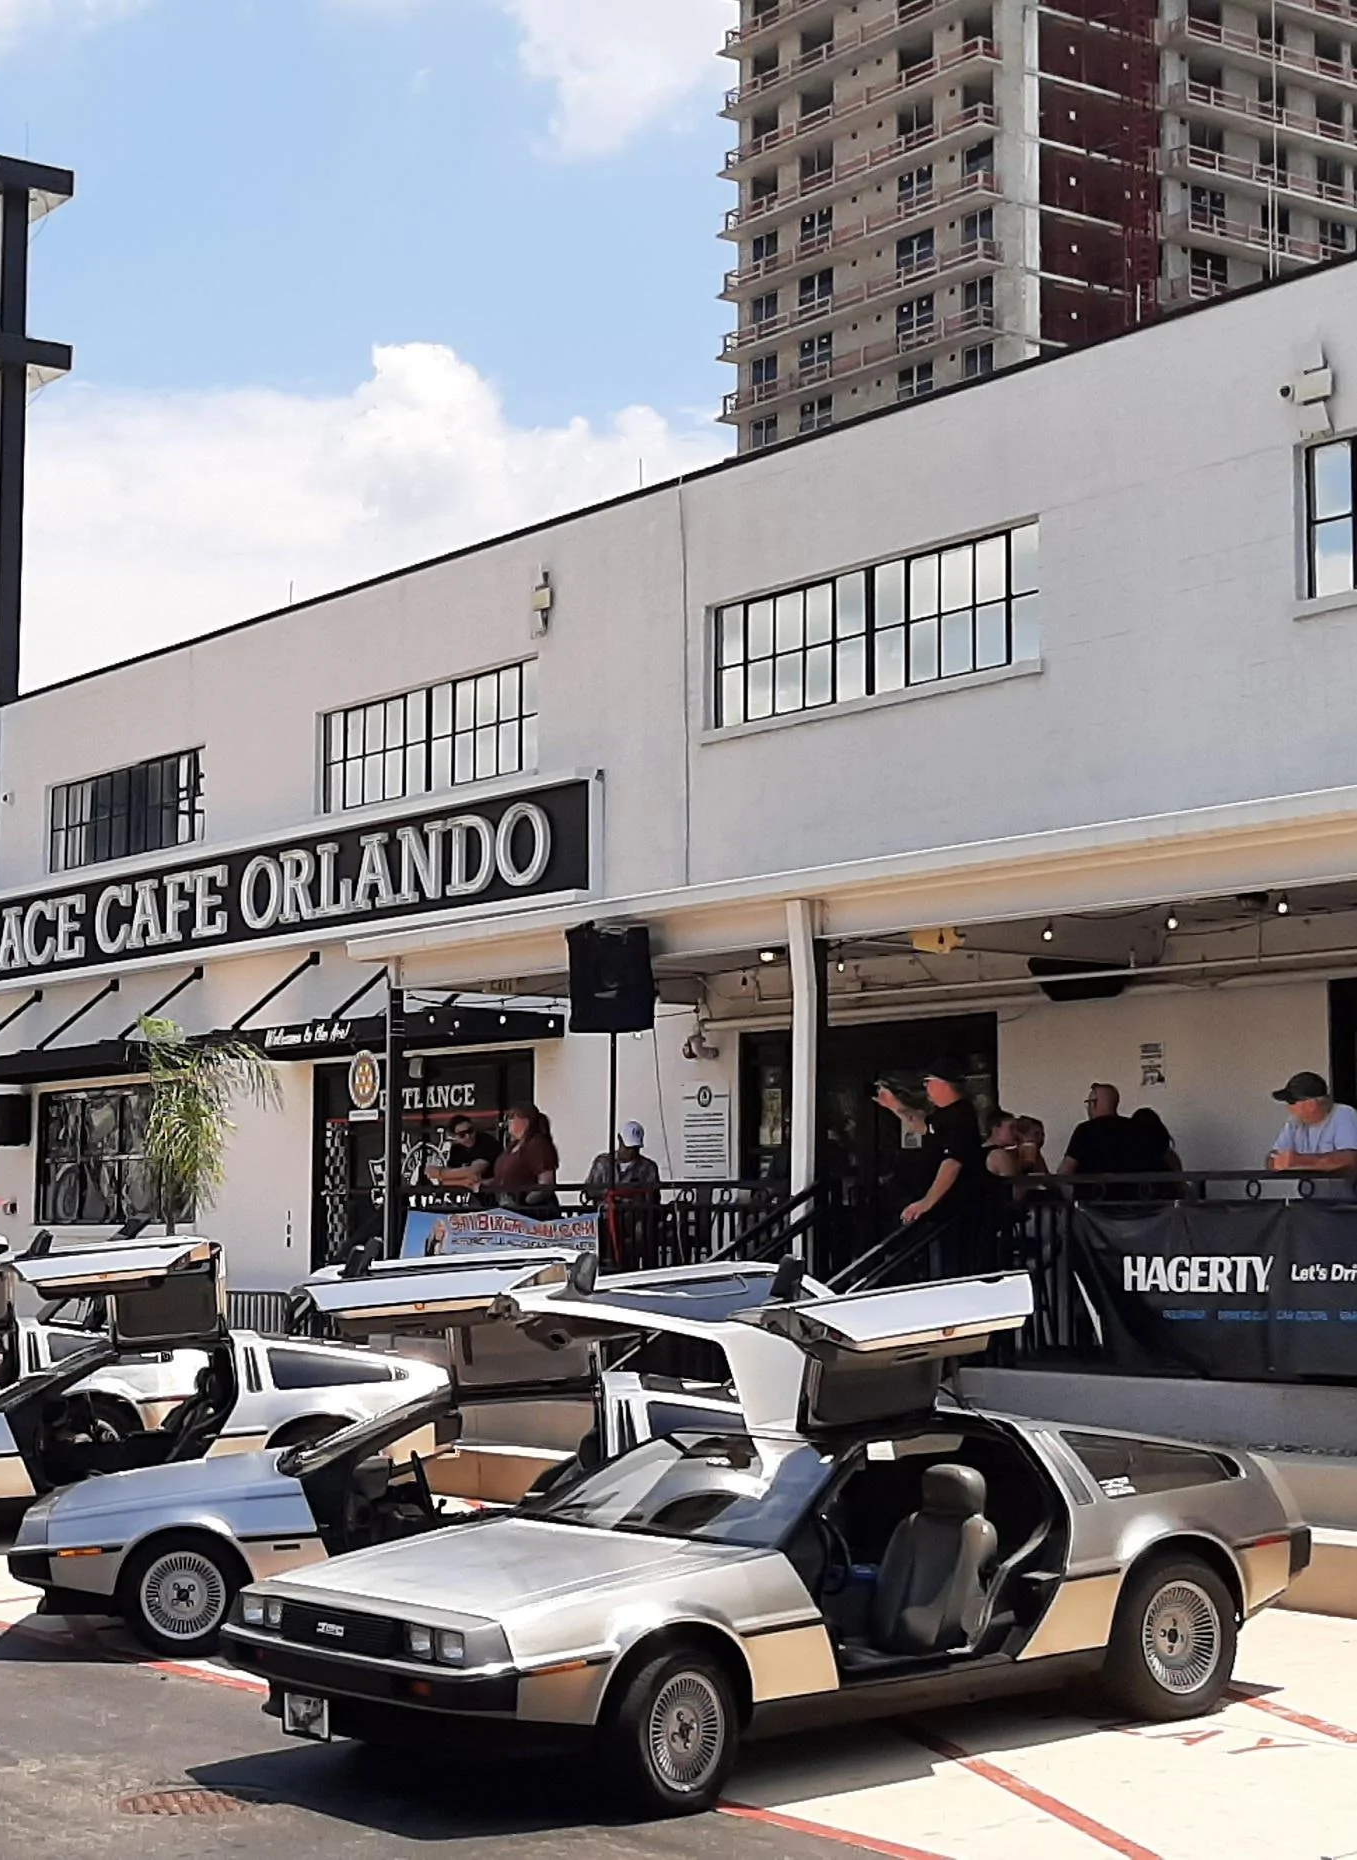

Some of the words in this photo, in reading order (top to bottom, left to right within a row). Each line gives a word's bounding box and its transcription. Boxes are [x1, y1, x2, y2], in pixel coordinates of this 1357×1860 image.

[94, 864, 229, 954] CAFE
[240, 801, 552, 931] ORLANDO
[1123, 1255, 1274, 1293] HAGERTY
[1291, 1264, 1328, 1282] Let's
